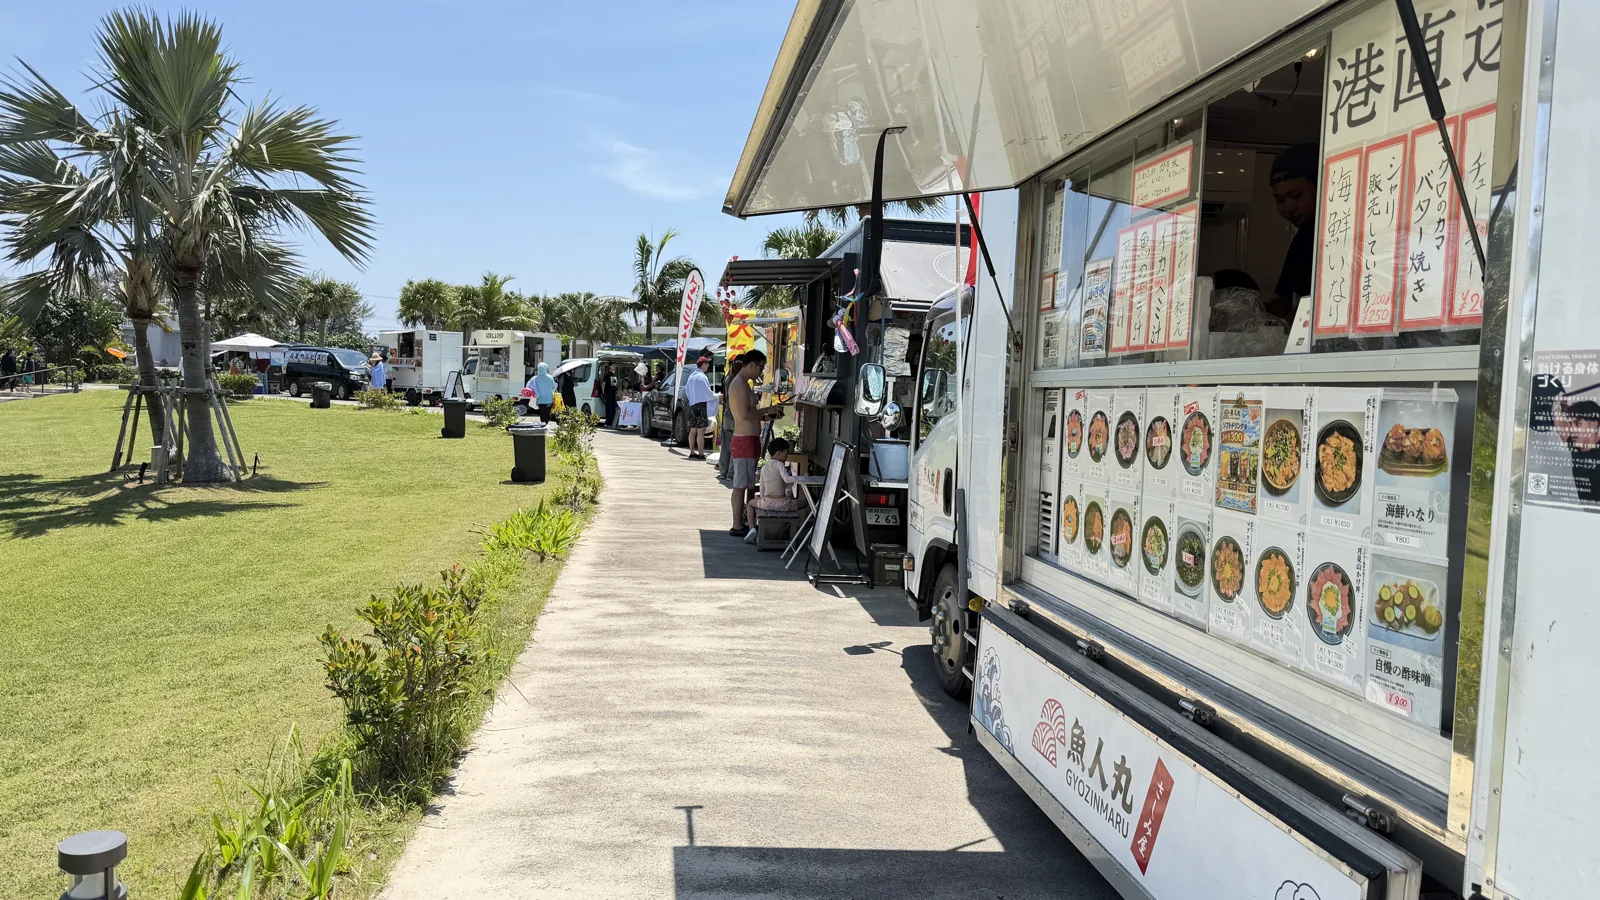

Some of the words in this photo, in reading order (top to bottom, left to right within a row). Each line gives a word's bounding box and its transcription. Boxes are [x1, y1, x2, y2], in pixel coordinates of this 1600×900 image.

[1386, 156, 1402, 228] シャリ
[1325, 167, 1352, 329] 海鮮いなり
[1362, 173, 1383, 308] 販売しています
[1407, 169, 1433, 303] バター焼き
[1132, 230, 1151, 341] 魚のラ汁
[1385, 503, 1435, 523] 海鮮いなり
[1395, 535, 1410, 545] ¥800
[1375, 658, 1431, 688] 自慢の酢味噌
[1065, 768, 1130, 839] GYOZINMARU
[1067, 717, 1134, 815] 魚人丸
[1137, 781, 1165, 858] さしみ屋
